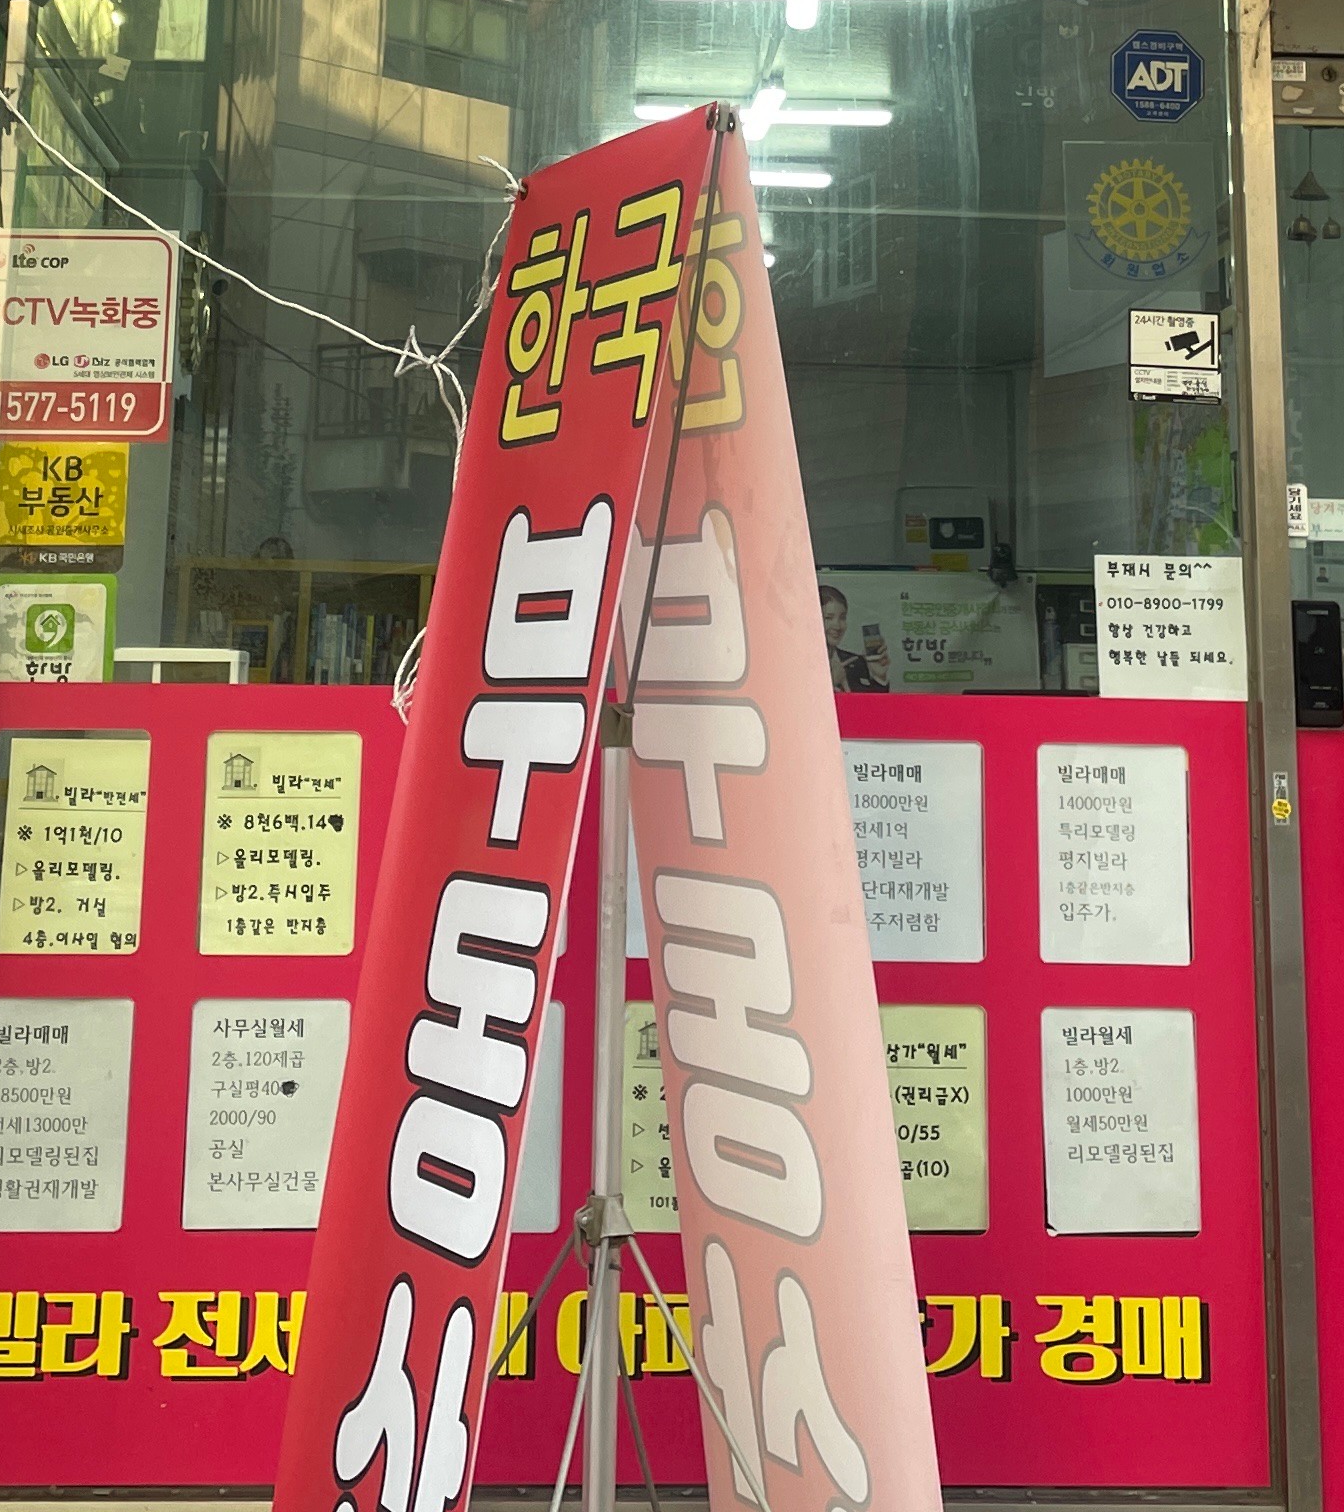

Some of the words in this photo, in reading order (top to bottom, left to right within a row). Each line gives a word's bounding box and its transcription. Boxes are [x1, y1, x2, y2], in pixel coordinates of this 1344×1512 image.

[1127, 61, 1188, 92] ADT
[41, 257, 69, 268] COP
[502, 187, 682, 441] 한국
[52, 357, 69, 366] LG
[42, 455, 83, 482] KB
[18, 487, 104, 518] 부동산
[39, 552, 57, 563] KB
[1107, 561, 1150, 577] 부재시
[1107, 597, 1224, 611] 010-8900-1799
[1108, 622, 1133, 639] 항상
[1143, 623, 1192, 639] 건강하고
[902, 638, 946, 663] 한방
[1109, 649, 1147, 665] 행복한
[1157, 650, 1180, 666] 날들
[854, 763, 922, 783] 빌라매매
[1058, 765, 1126, 785] 빌라매매
[854, 794, 928, 812] 18000만원
[1059, 796, 1133, 814] 14000만원
[244, 813, 344, 832] 8천6백.14
[854, 821, 908, 839] 전세1억
[45, 826, 122, 845] 1억1천/10
[1058, 823, 1135, 842] 특리모델링
[856, 850, 923, 869] 평지빌라
[1059, 851, 1128, 871] 평지빌라
[77, 897, 106, 917] 거실
[227, 917, 274, 936] 1층같은
[867, 912, 940, 933] 주저렴함
[110, 932, 137, 950] 협의
[213, 1017, 304, 1039] 사무실월세
[1062, 1026, 1133, 1046] 빌라월세
[211, 1080, 299, 1098] 구실평40
[1066, 1086, 1133, 1104] 1000만원
[209, 1110, 276, 1127] 2000/90
[1067, 1114, 1149, 1133] 월세50만원
[895, 1124, 940, 1143] 0/55
[209, 1139, 244, 1159] 공실
[1068, 1143, 1174, 1164] 리모델링된집
[207, 1171, 319, 1192] 본사무실건물
[917, 1293, 1010, 1376] 가
[1035, 1295, 1202, 1381] 경매
